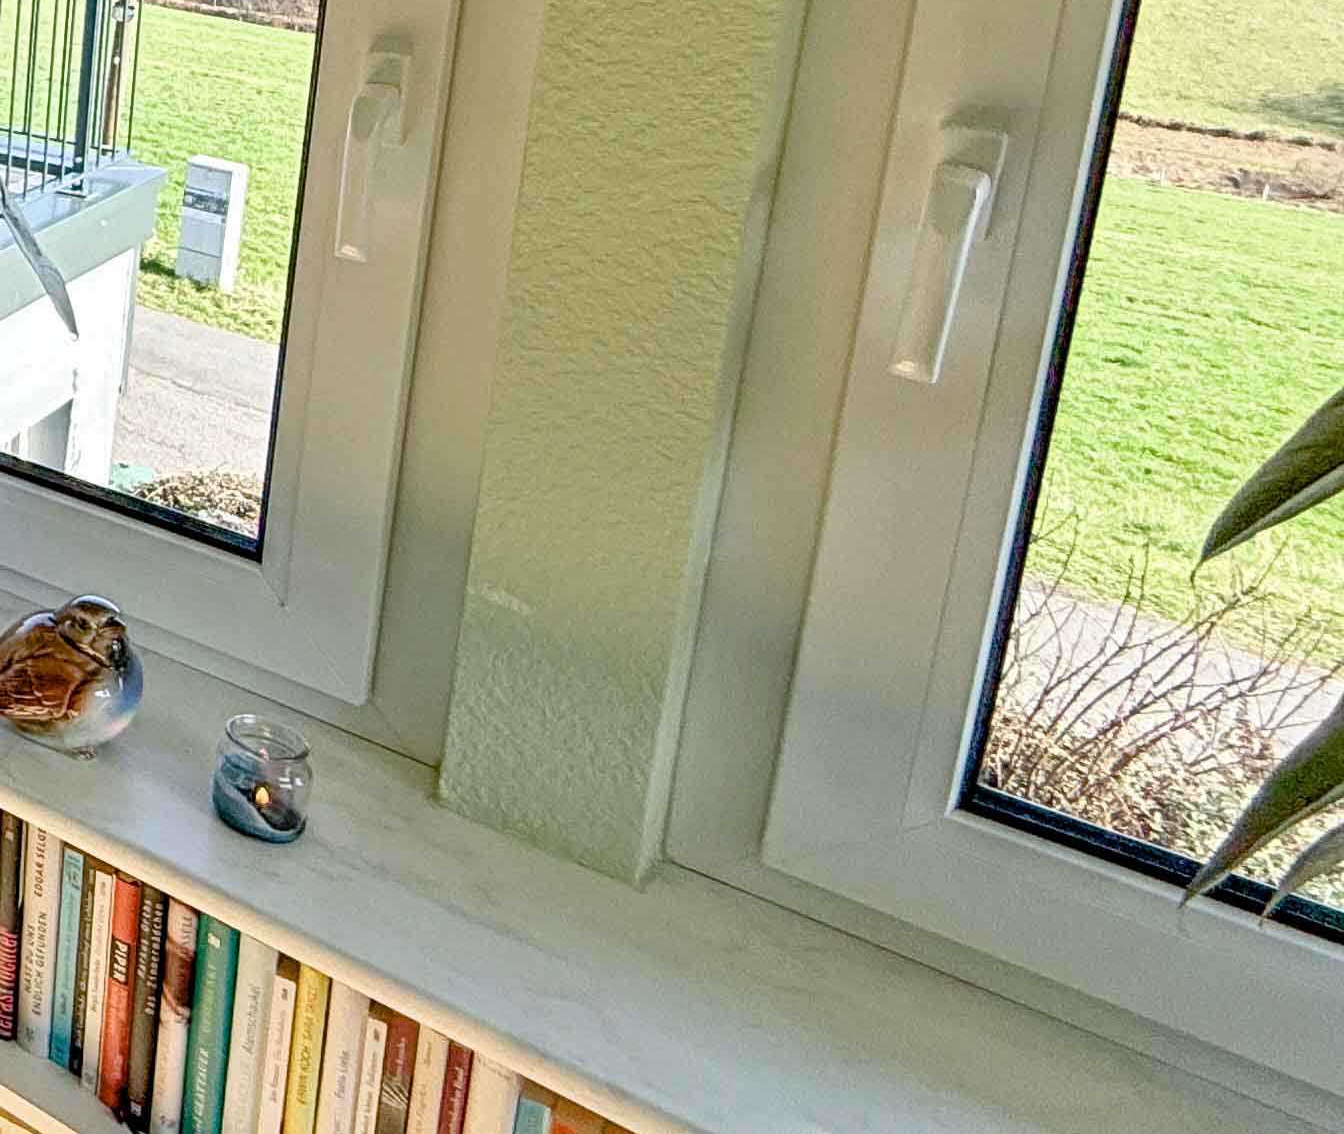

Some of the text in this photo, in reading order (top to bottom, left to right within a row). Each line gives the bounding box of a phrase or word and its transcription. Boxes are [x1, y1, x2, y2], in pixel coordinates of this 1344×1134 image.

[33, 827, 48, 898] EDGAR SELGE
[24, 971, 33, 994] HAST
[31, 912, 48, 1017] ENDLICH GEFUNDEN
[113, 941, 128, 983] PIPER
[144, 903, 164, 1016] Das Zimmermädchen
